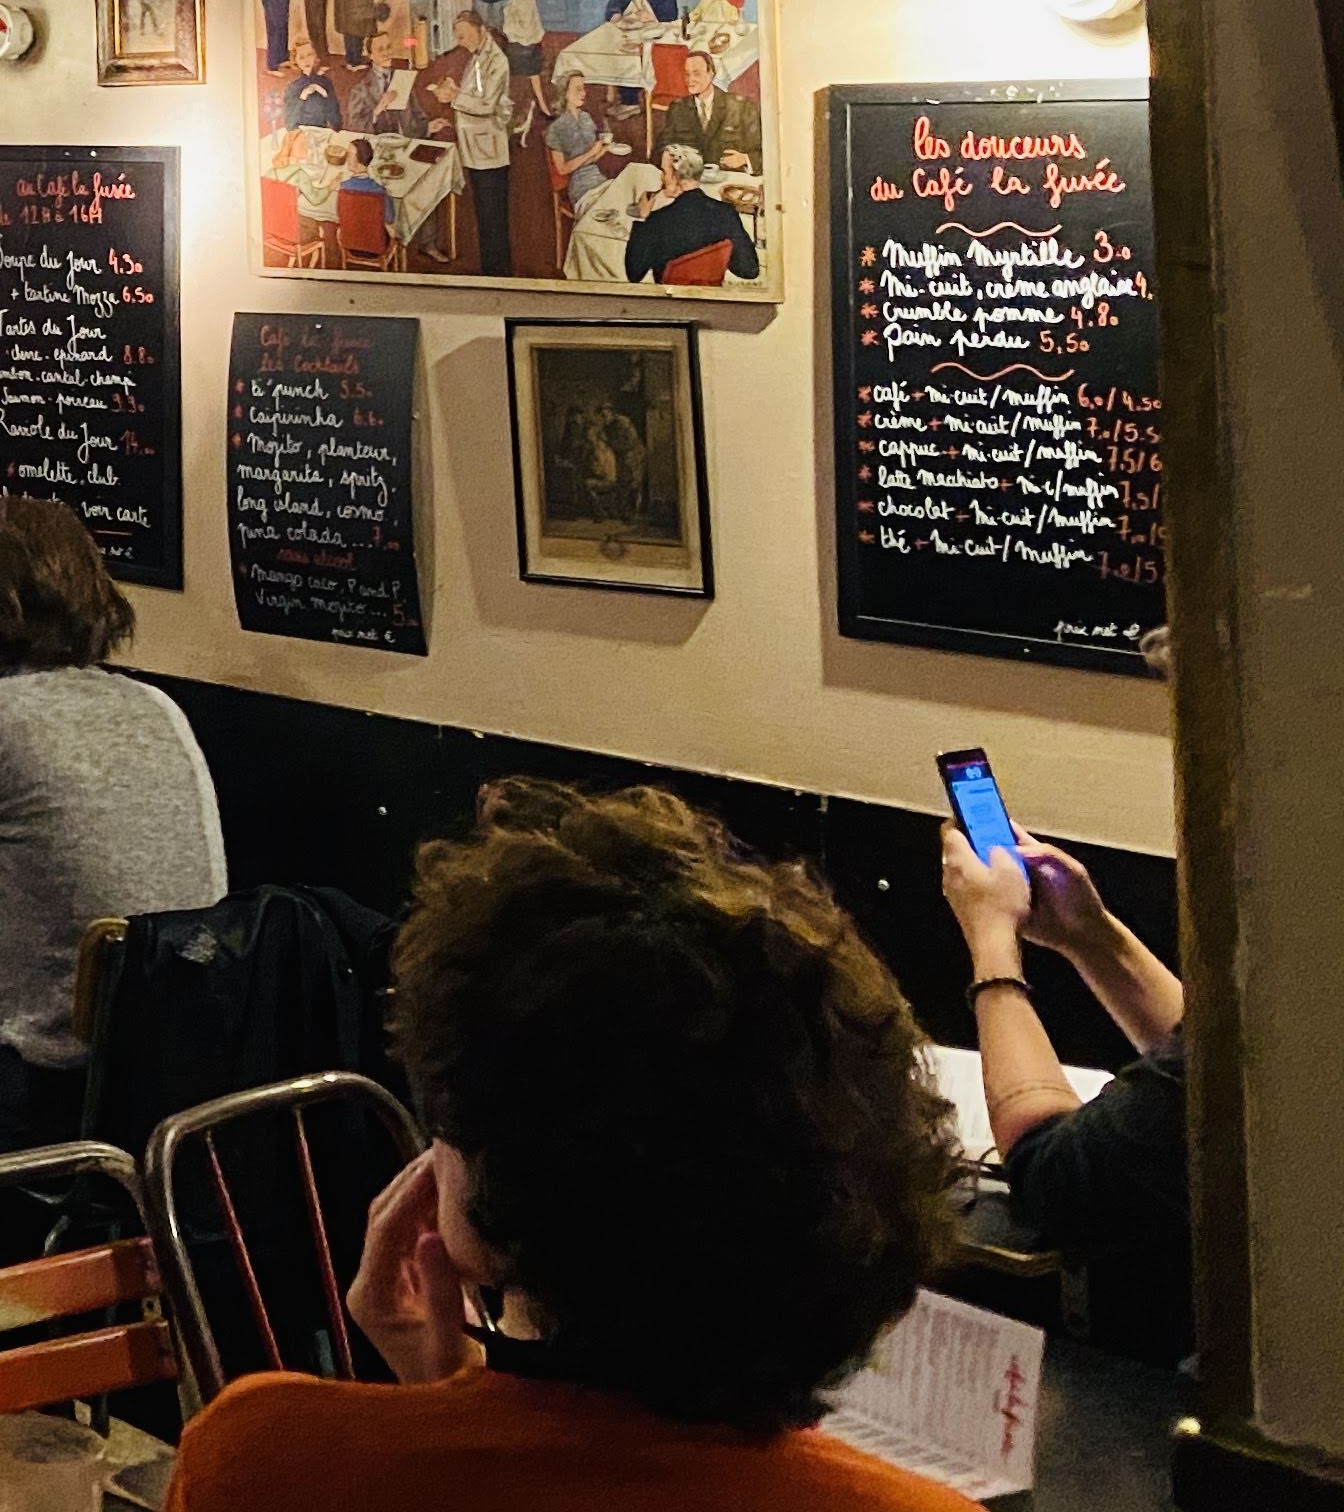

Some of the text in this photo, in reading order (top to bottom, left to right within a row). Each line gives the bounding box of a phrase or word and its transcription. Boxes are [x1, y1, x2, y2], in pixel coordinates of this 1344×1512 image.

[914, 115, 1087, 160] les douceurs
[72, 170, 90, 196] la
[90, 172, 136, 213] fusée
[870, 157, 1127, 212] du Café la fusée
[40, 244, 62, 269] du
[109, 248, 145, 275] 4.30
[882, 236, 1085, 280] Muffin Myrtille
[24, 281, 72, 303] tartine
[73, 284, 120, 319] Mozza
[122, 286, 155, 304] 6.50
[1052, 269, 1138, 310] anglaise
[42, 318, 63, 337] du
[882, 300, 1119, 333] Crumble pomme 4.80
[883, 322, 942, 363] Pain
[949, 328, 1030, 357] perdu
[873, 380, 911, 412] café
[58, 422, 78, 439] du
[874, 410, 928, 432] crème
[117, 505, 151, 528] carte
[237, 486, 267, 523] long
[878, 494, 955, 520] chocolat
[880, 525, 911, 554] thé
[384, 630, 396, 643] €
